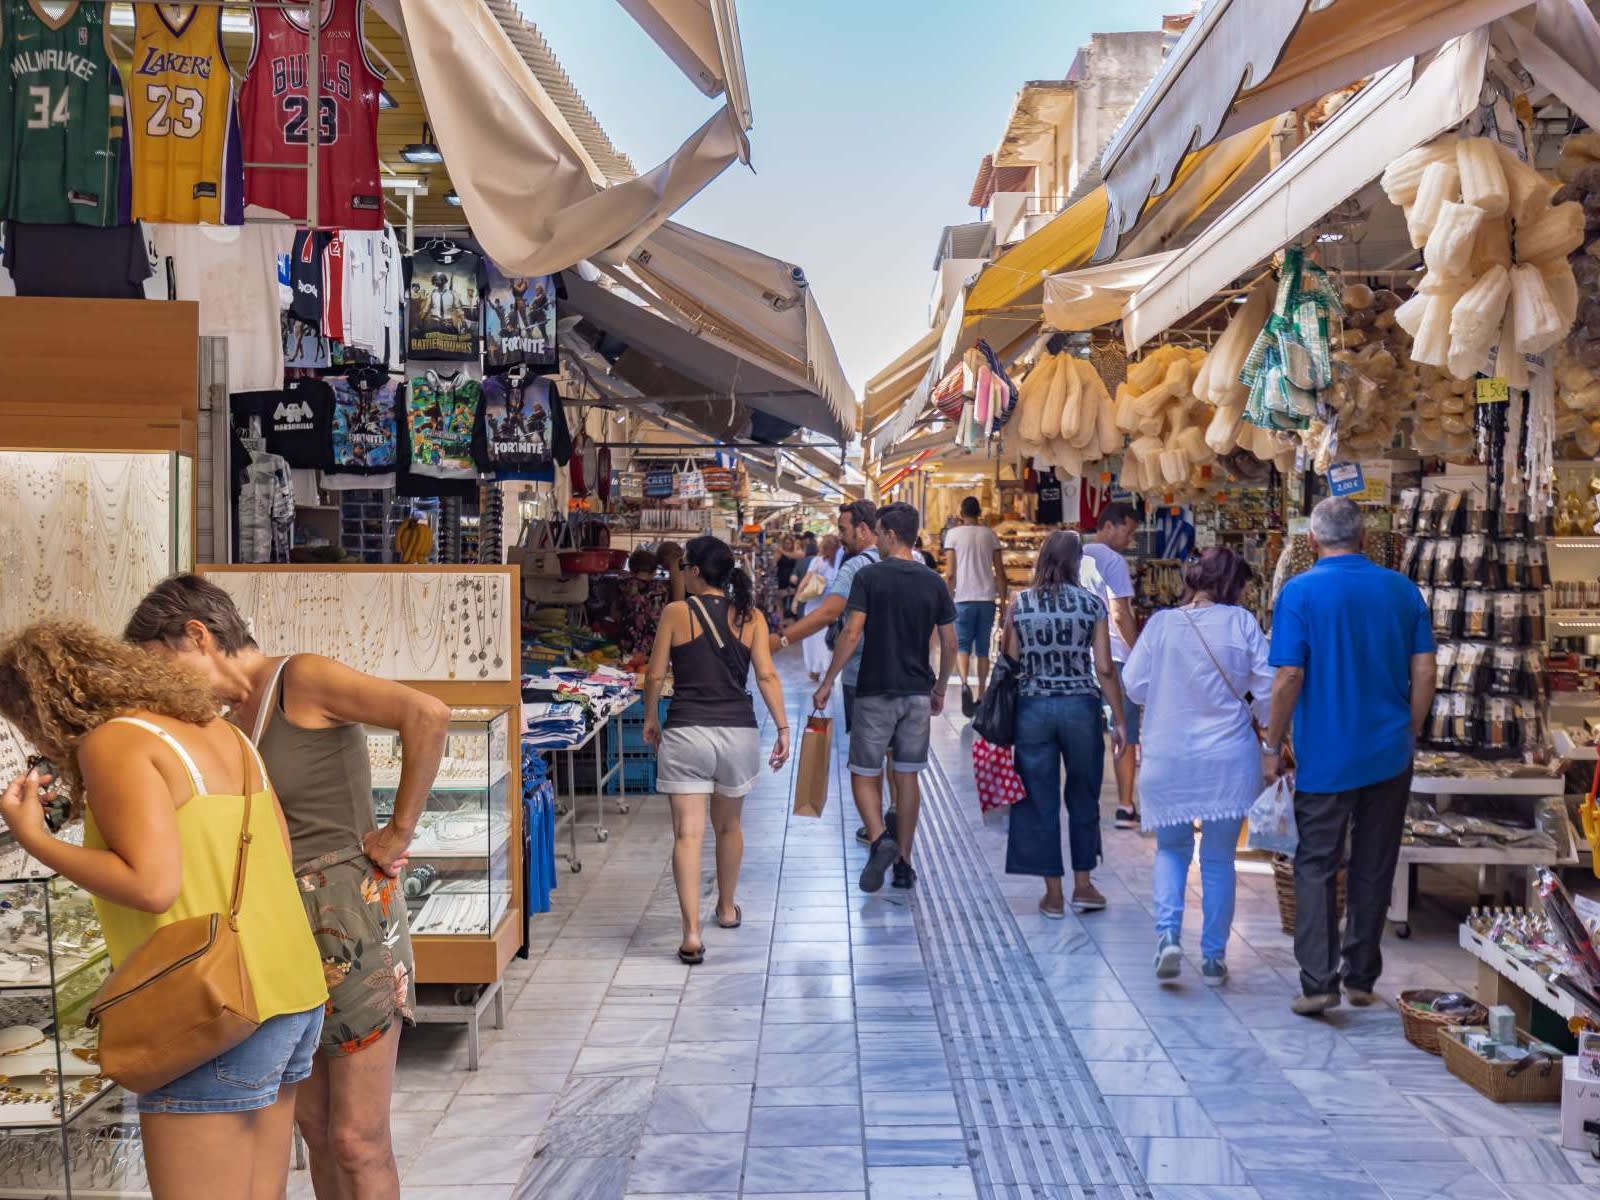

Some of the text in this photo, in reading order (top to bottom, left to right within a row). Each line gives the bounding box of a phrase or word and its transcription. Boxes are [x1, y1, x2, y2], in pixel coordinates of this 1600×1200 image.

[10, 50, 98, 82] MILWAUKEE
[136, 47, 212, 79] LAKERS
[27, 85, 71, 129] 34
[146, 84, 205, 139] 23
[283, 95, 340, 146] 23
[502, 336, 545, 354] FORTNITE
[494, 441, 545, 455] FORTNITE
